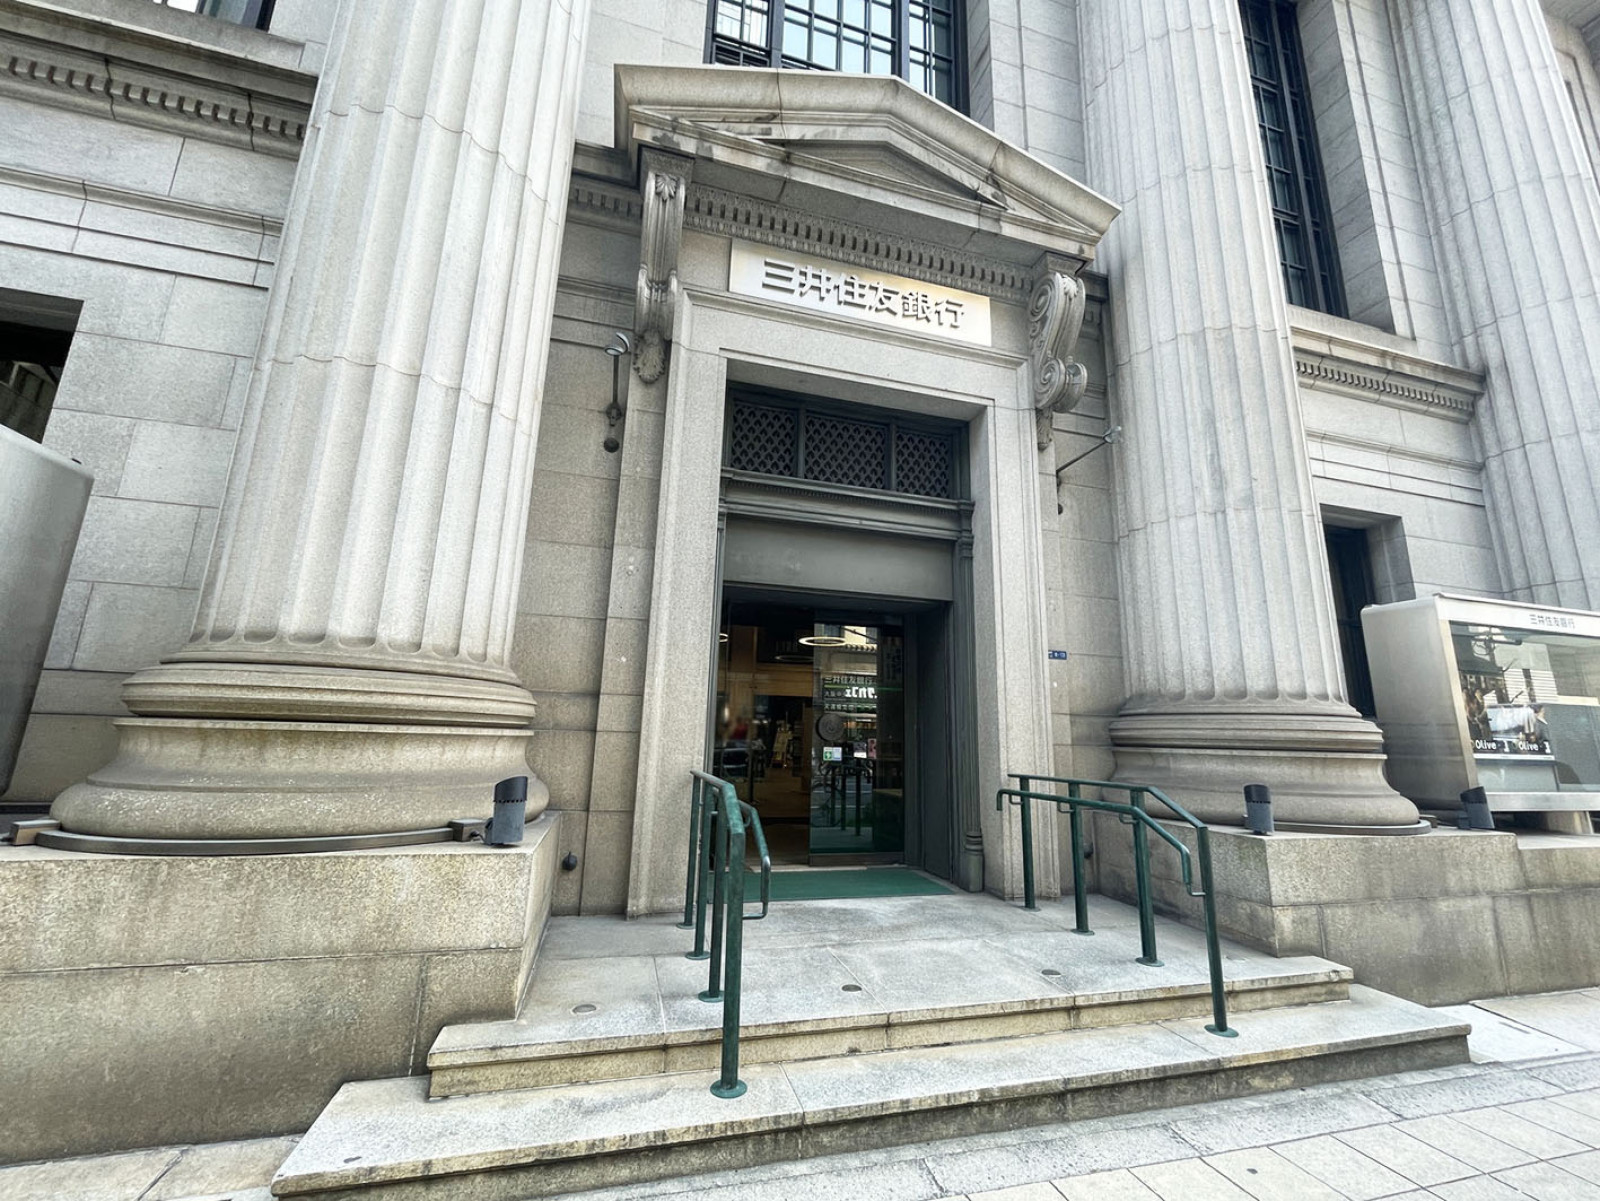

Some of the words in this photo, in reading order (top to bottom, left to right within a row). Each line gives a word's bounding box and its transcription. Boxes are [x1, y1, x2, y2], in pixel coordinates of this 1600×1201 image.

[762, 259, 964, 328] 三井住友銀行
[1475, 739, 1497, 749] Olive
[1518, 741, 1539, 751] Olive
